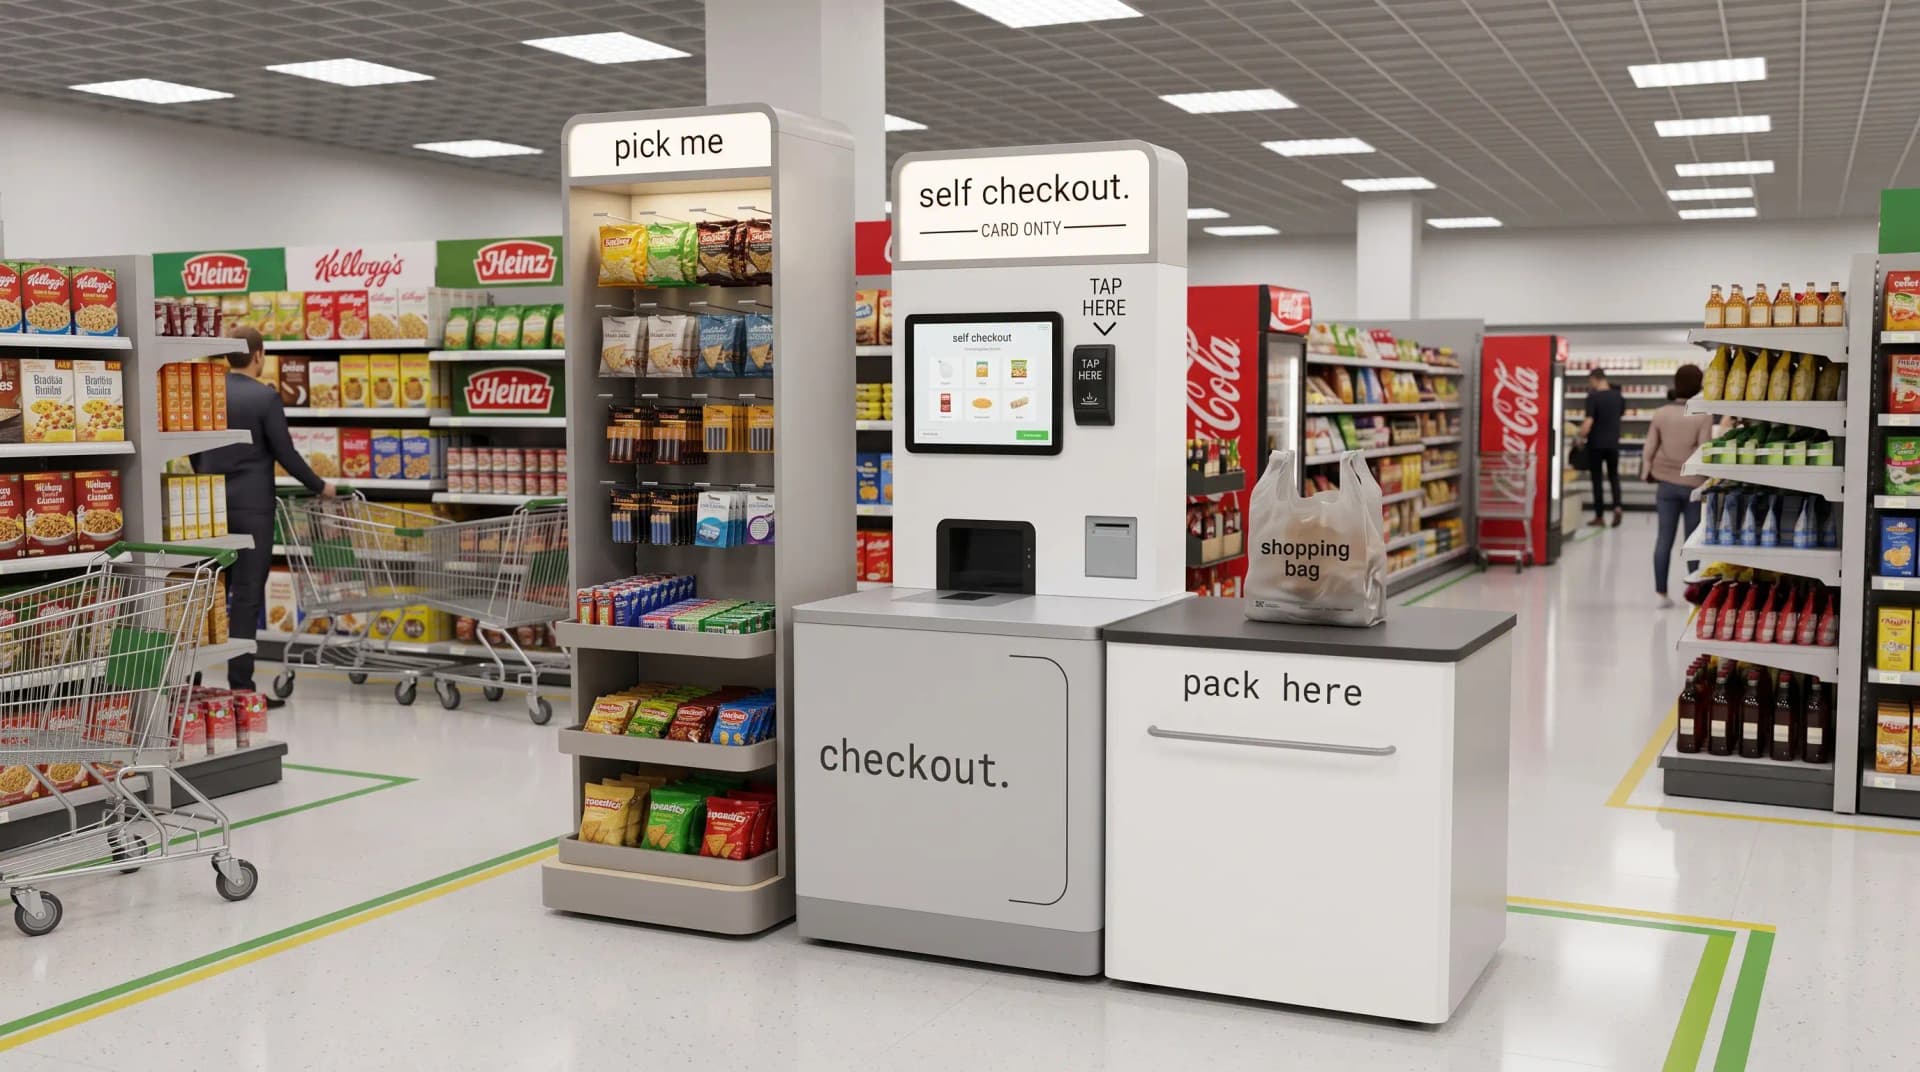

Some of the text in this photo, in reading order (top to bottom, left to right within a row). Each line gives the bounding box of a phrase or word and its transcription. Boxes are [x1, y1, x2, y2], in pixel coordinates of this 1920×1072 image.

[615, 129, 724, 167] pick me
[919, 173, 1130, 208] self checkout.
[981, 222, 1019, 238] CARD
[315, 248, 404, 287] Kellogg's
[481, 247, 549, 277] Heinz
[27, 271, 66, 290] Kellogg's
[76, 275, 114, 293] Kellogg's
[188, 261, 244, 287] Heinz
[1089, 277, 1122, 295] TAP
[1083, 299, 1127, 316] HERE
[952, 332, 1012, 343] self checkout
[1078, 369, 1103, 381] HERE
[1080, 358, 1100, 369] TAP
[471, 377, 545, 406] Heinz
[1260, 538, 1350, 562] shopping
[1285, 559, 1320, 582] bag
[1184, 670, 1362, 706] pack here
[820, 737, 1009, 789] checkout.
